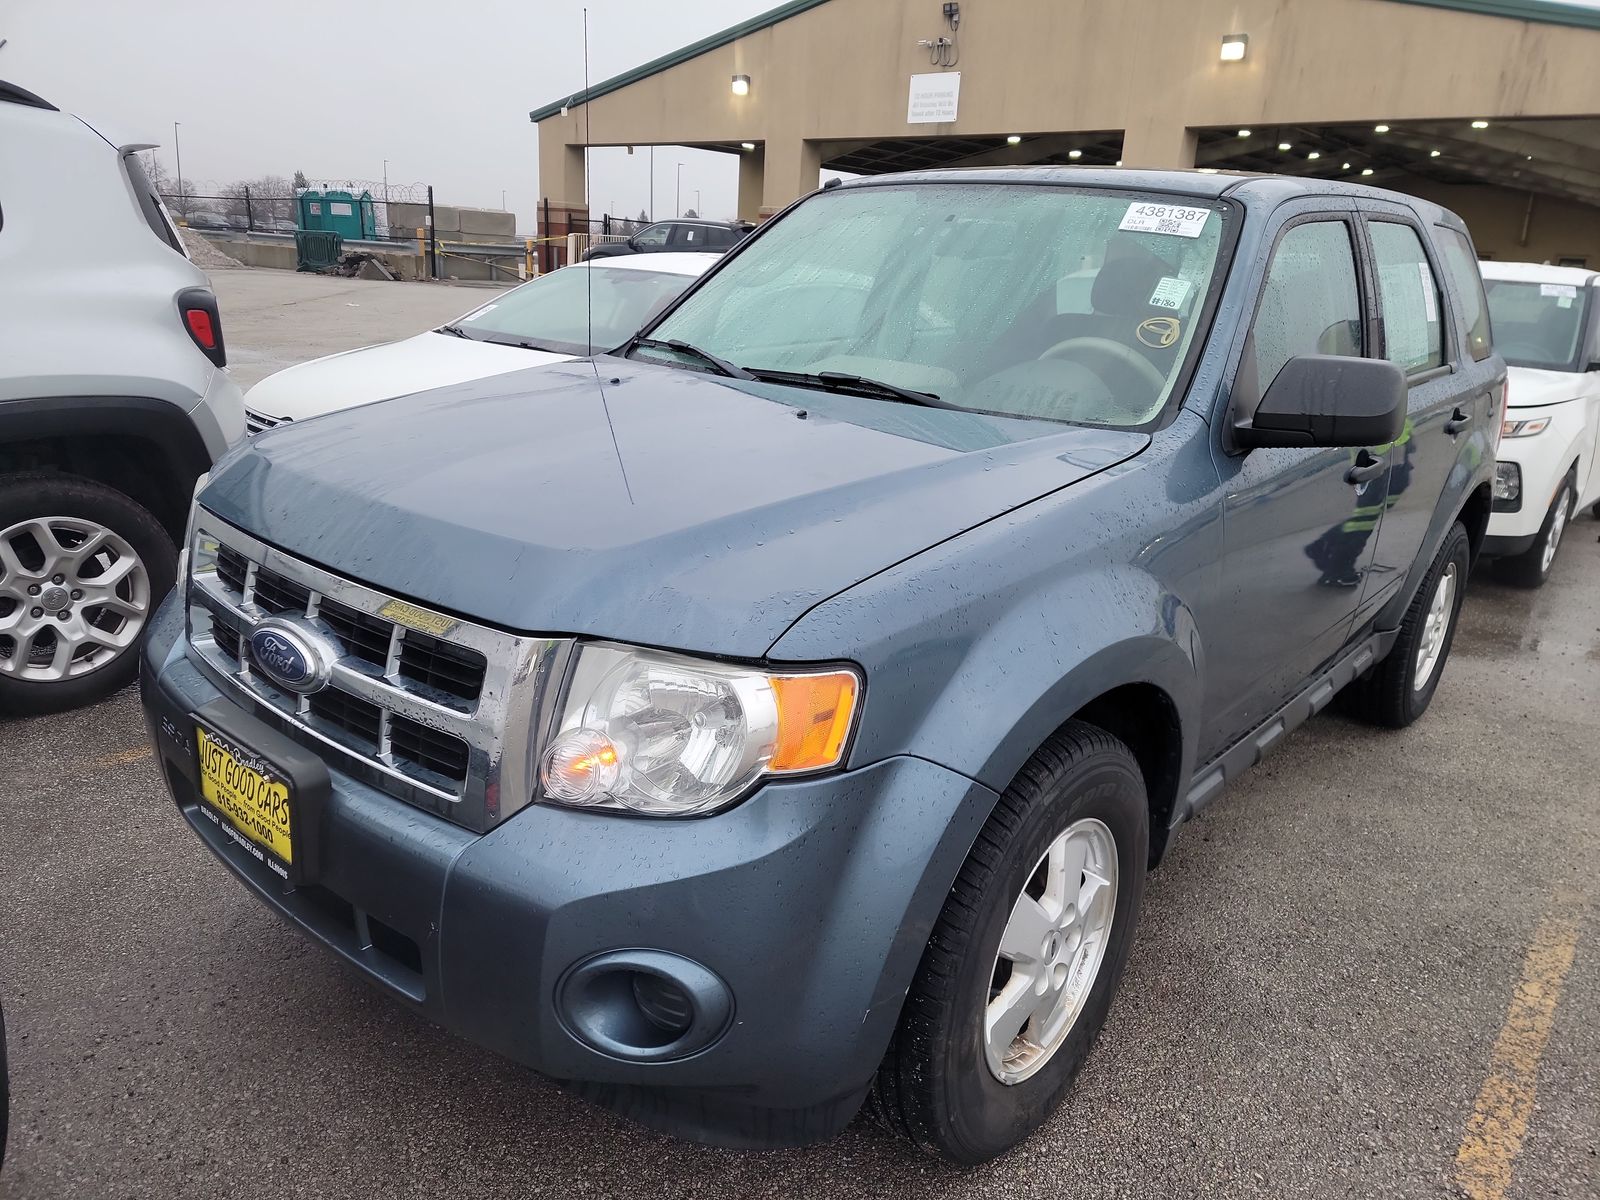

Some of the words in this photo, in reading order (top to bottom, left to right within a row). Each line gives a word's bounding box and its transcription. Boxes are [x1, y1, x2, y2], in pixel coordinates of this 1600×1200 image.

[1135, 205, 1207, 222] 4381387
[259, 636, 295, 674] Ford
[200, 739, 223, 778] JUST
[225, 757, 255, 801] GOOD
[257, 781, 290, 825] CARS
[207, 771, 220, 788] Good
[220, 782, 238, 801] People
[243, 799, 256, 815] from
[256, 808, 271, 825] Good
[271, 821, 292, 840] People
[200, 805, 219, 823] BRADLEY
[267, 858, 288, 880] ILLINOIS
[216, 790, 274, 844] 815-932-1000
